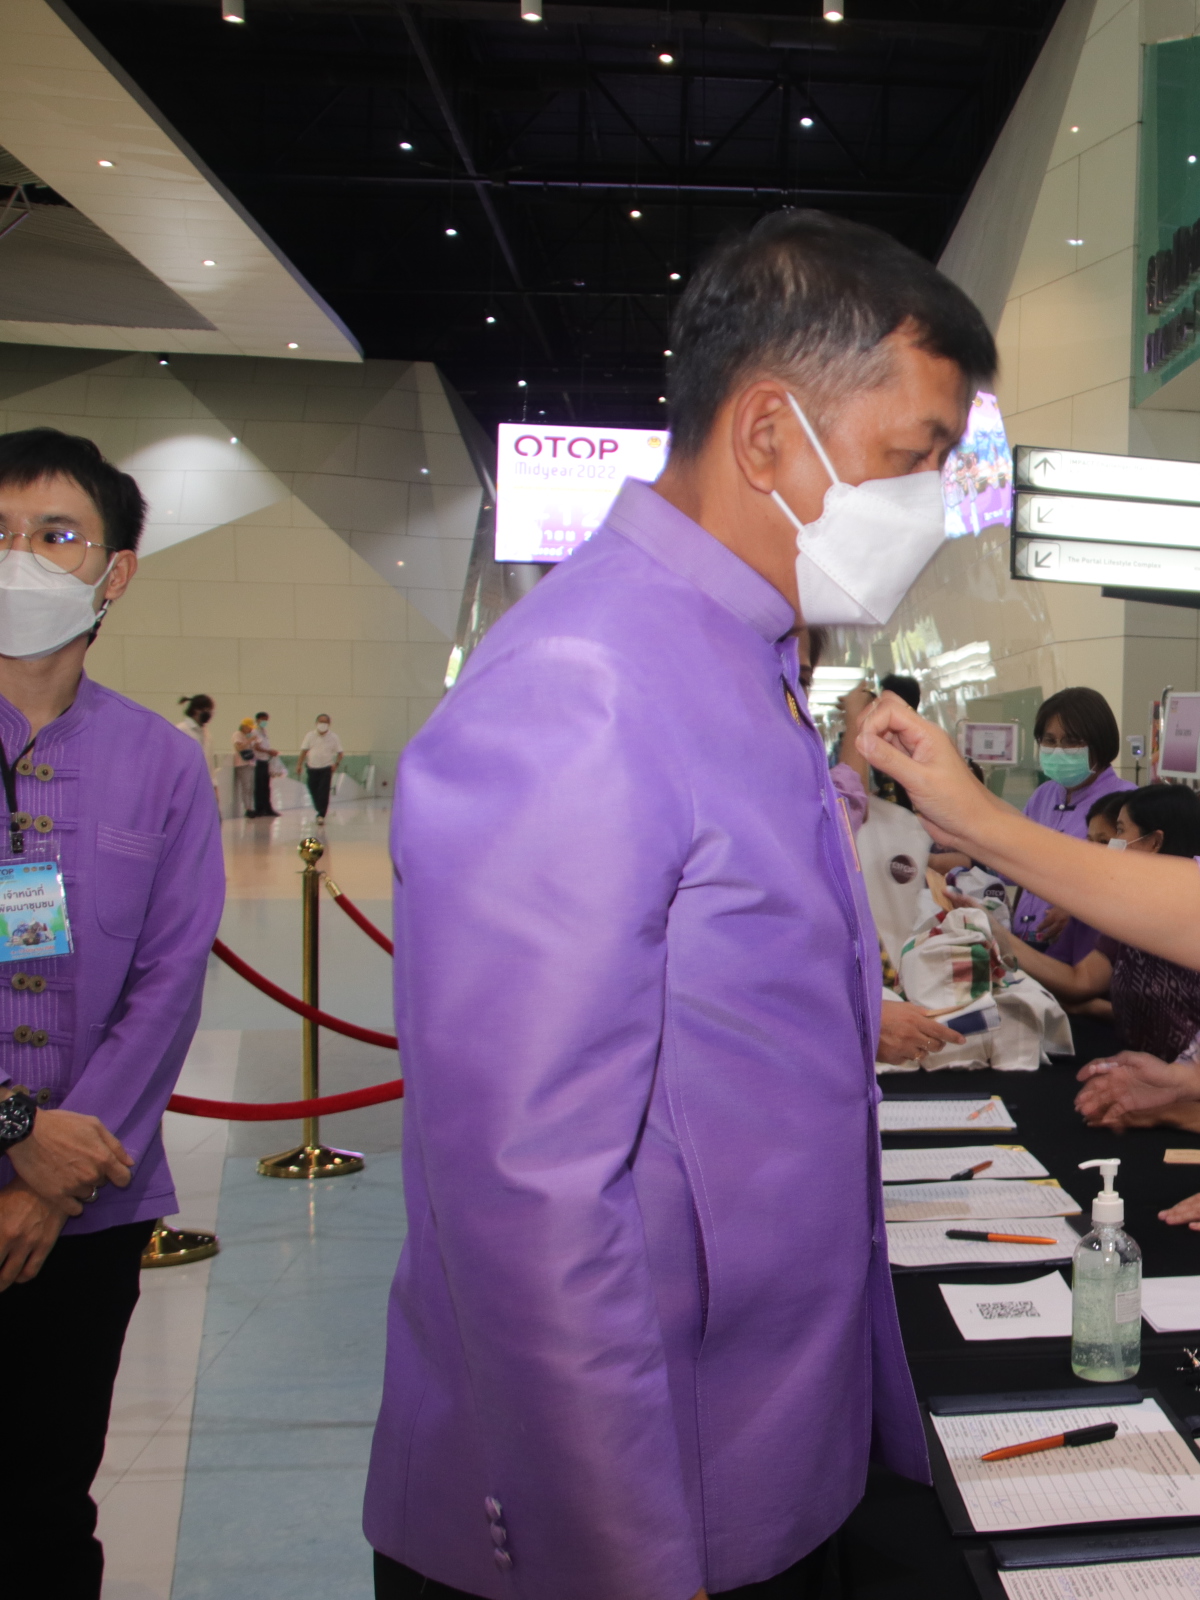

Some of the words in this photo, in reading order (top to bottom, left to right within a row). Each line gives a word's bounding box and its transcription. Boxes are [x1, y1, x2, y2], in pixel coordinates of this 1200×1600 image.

[514, 434, 619, 460] OTOP
[515, 461, 573, 480] Midyear
[576, 464, 616, 479] 2022
[1067, 555, 1080, 563] The
[1081, 556, 1102, 565] Portal
[1103, 558, 1132, 567] Lifestyle
[1132, 560, 1162, 570] Complex
[3, 883, 44, 900] เจ้าหน้าที่
